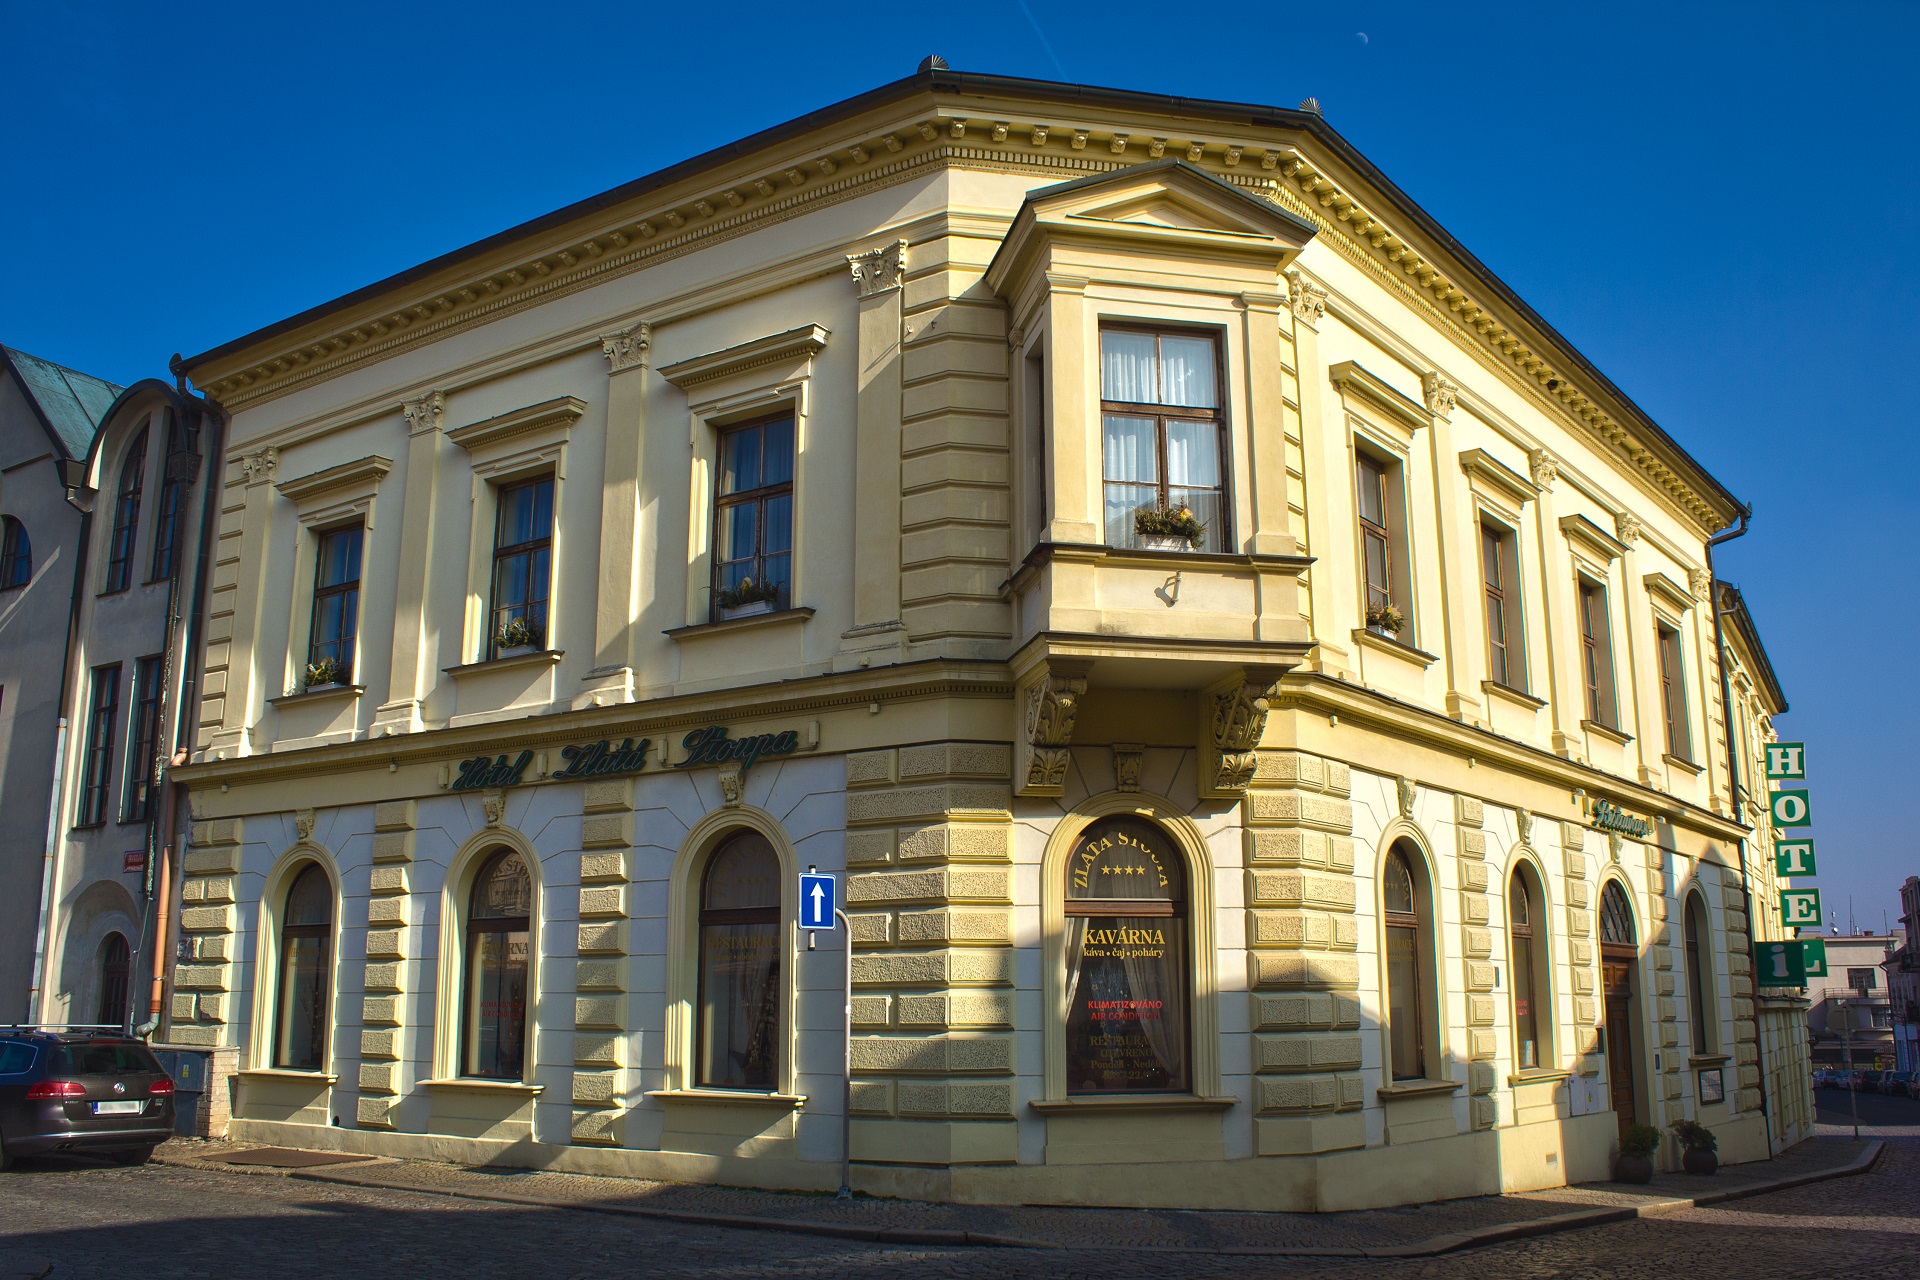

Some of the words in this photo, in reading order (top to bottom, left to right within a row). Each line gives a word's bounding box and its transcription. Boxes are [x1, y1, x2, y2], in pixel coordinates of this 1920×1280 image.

[452, 749, 534, 790] Hotel
[673, 725, 798, 770] Stoupa
[1083, 925, 1165, 945] KAVÁRNA
[1083, 947, 1105, 957] káva
[1112, 947, 1125, 960] čaj
[1132, 947, 1164, 959] poháry
[1087, 999, 1163, 1009] KLIMATIZOVÁNO
[1091, 1011, 1106, 1020] AIR
[1108, 1011, 1159, 1020] CONDITION
[1090, 1036, 1159, 1046] RESTAURA
